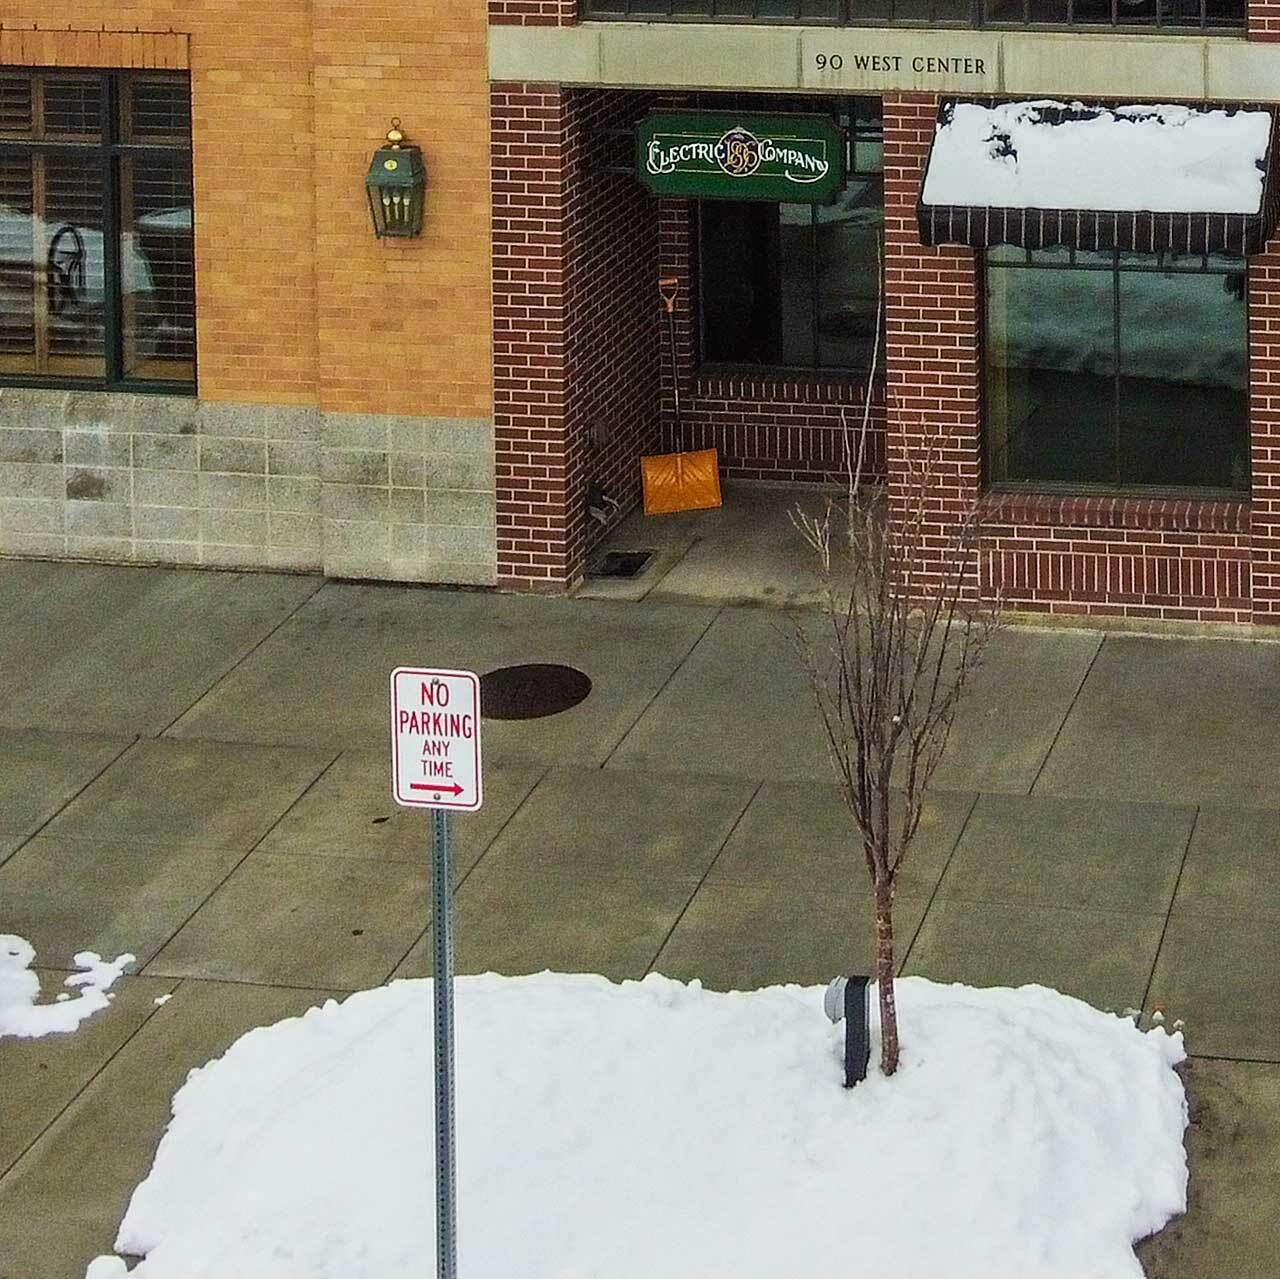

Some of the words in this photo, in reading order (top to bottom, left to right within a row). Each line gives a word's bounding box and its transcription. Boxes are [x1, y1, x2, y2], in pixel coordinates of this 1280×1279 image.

[815, 54, 843, 70] 90
[854, 55, 902, 71] WEST
[912, 57, 986, 74] CENTER
[647, 141, 725, 174] ELECTRIC
[758, 139, 829, 183] COMPANY
[421, 682, 449, 707] NO
[400, 710, 472, 739] PARKING
[422, 740, 450, 757] ANY
[421, 760, 453, 778] TIME
